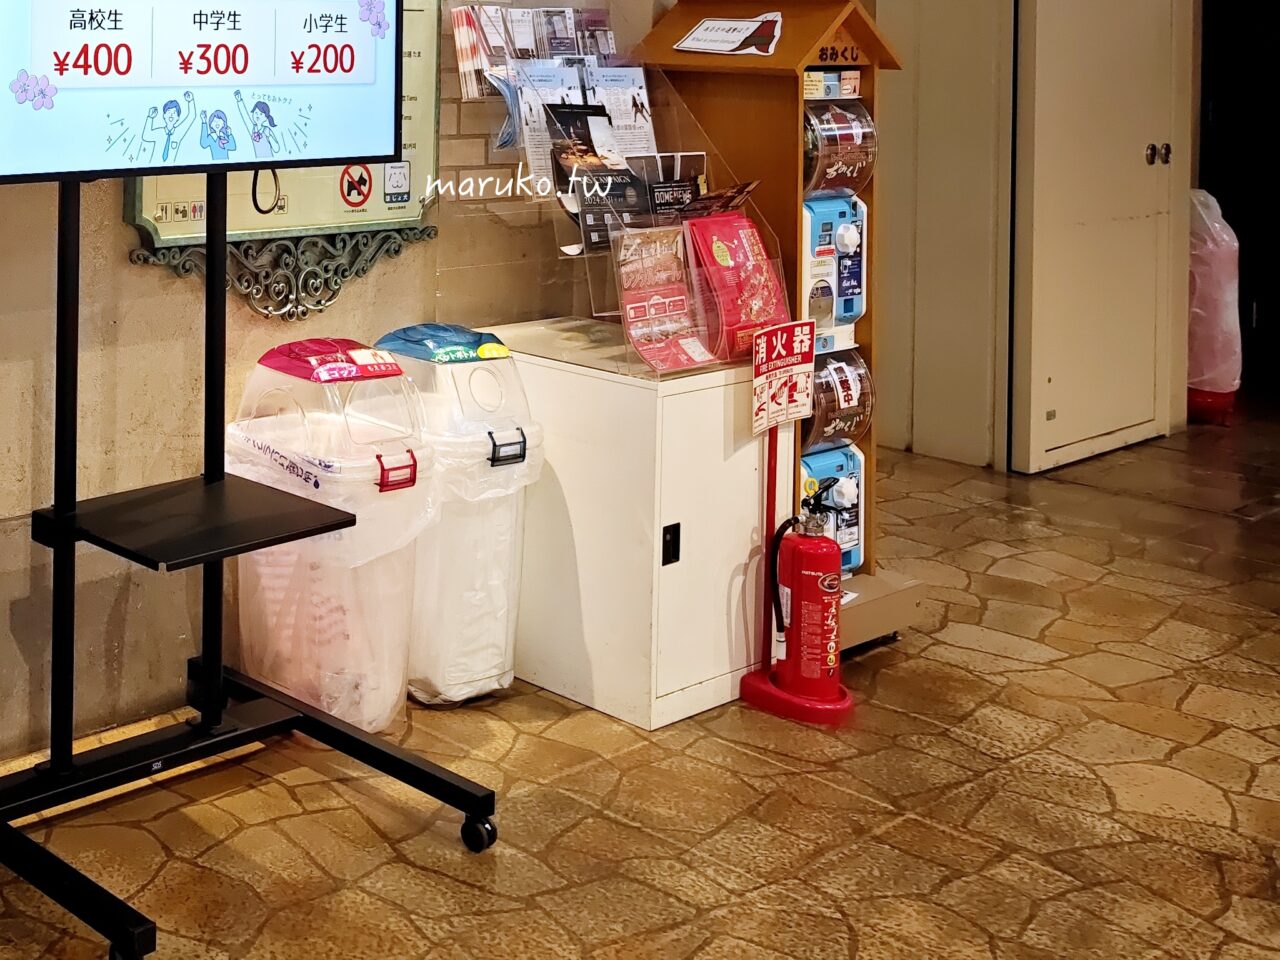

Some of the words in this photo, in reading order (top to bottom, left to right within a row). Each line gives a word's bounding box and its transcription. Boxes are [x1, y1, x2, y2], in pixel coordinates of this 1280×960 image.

[69, 8, 124, 31] 高校生
[193, 10, 242, 31] 中学生
[303, 13, 348, 33] 小学生
[53, 43, 132, 76] ¥400
[178, 43, 249, 75] ¥300
[290, 43, 355, 75] ¥200
[818, 46, 859, 62] おみくじ
[755, 325, 811, 365] 消火器
